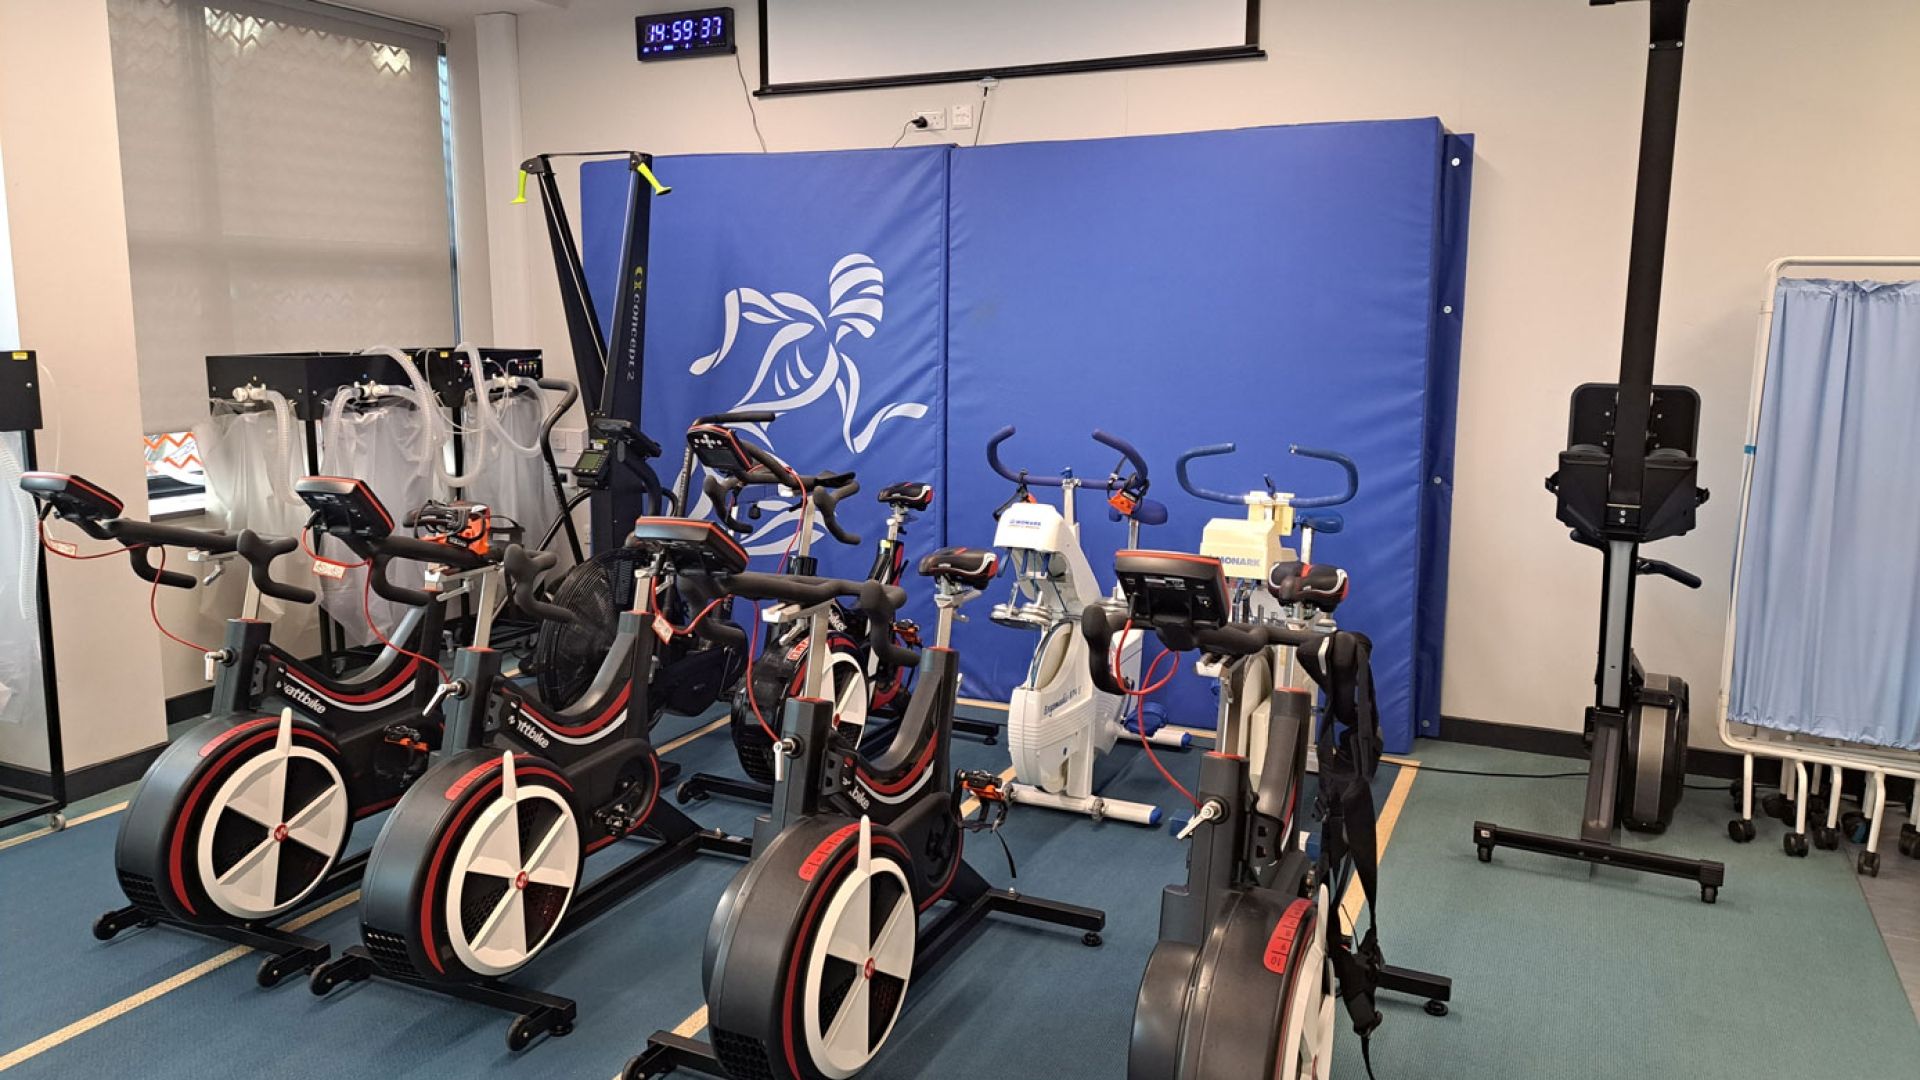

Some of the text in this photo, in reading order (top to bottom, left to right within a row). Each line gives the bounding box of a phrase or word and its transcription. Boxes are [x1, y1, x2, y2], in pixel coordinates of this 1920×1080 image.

[650, 16, 722, 43] 14:59:37
[628, 293, 640, 367] concept
[284, 682, 326, 714] attbike
[517, 720, 550, 748] ttbike
